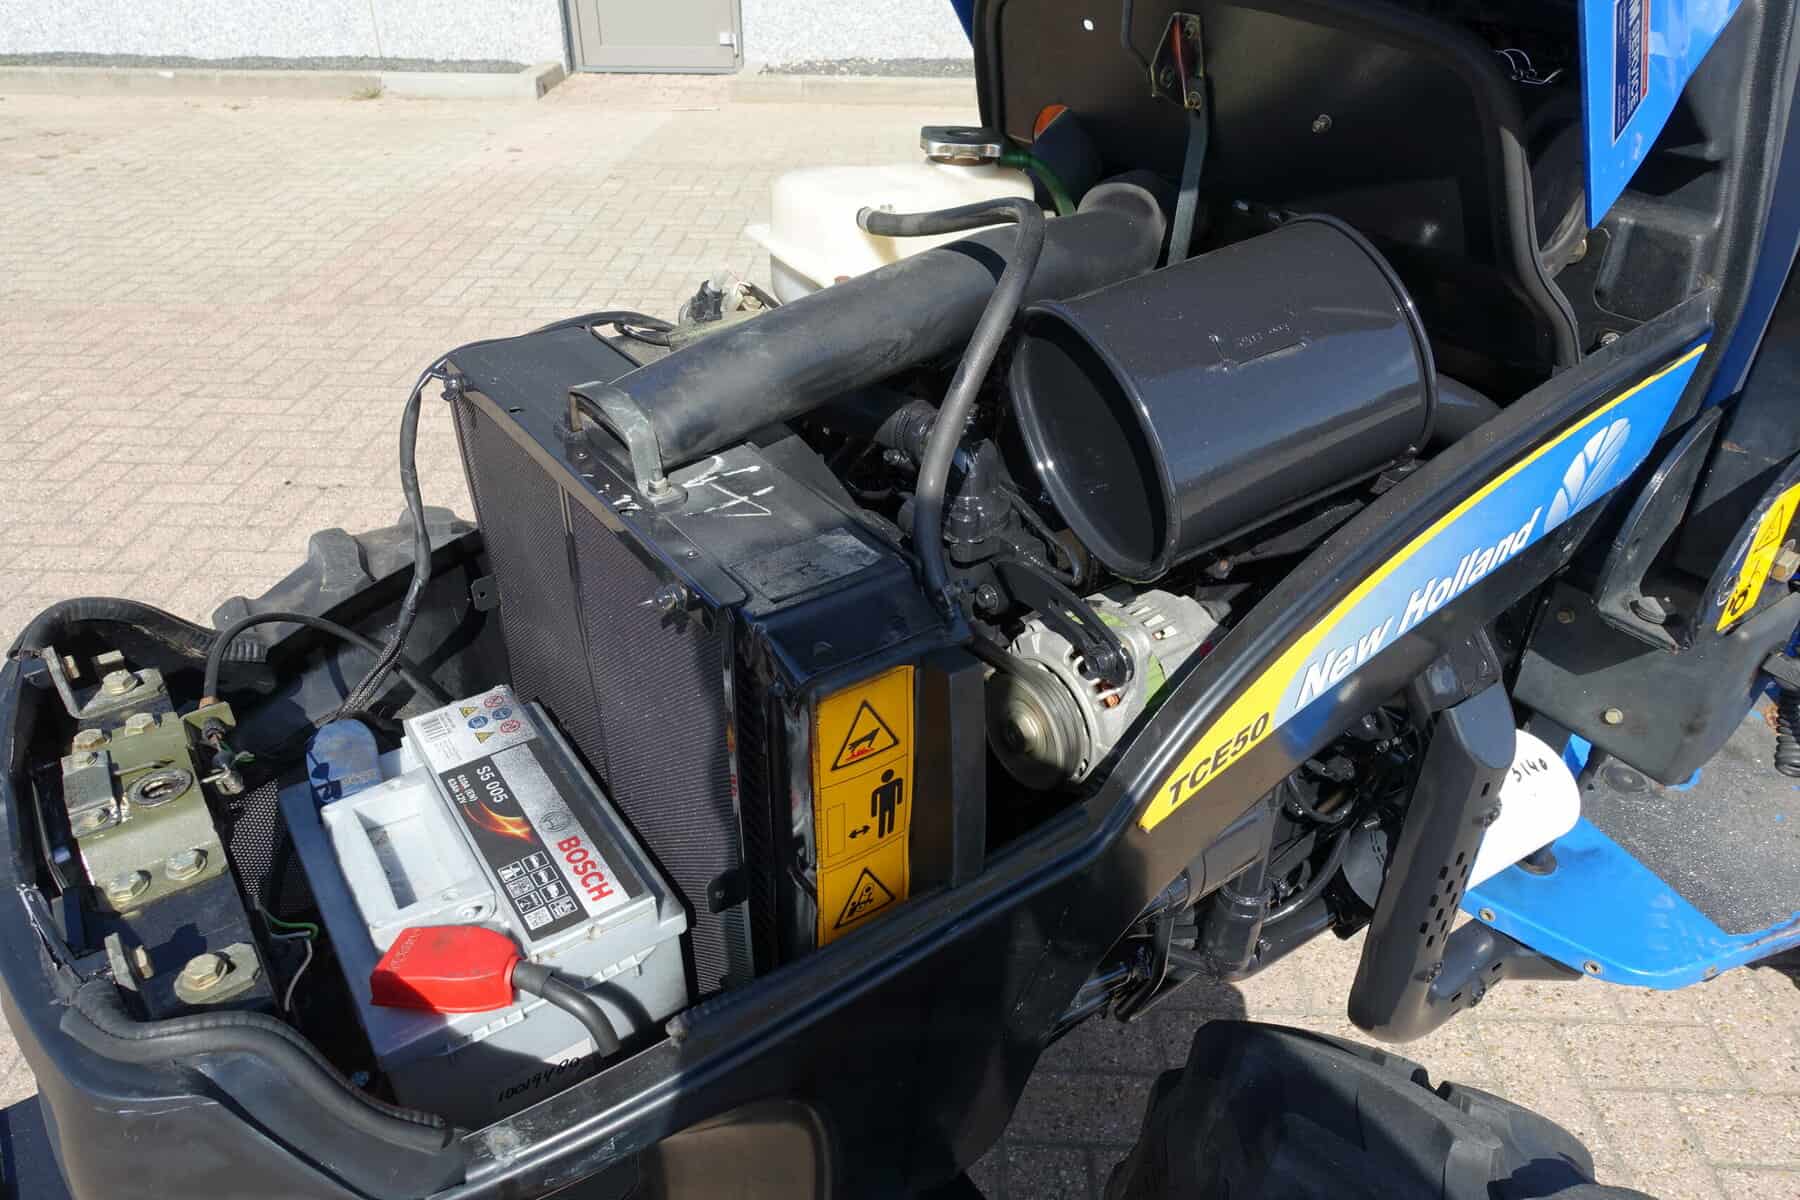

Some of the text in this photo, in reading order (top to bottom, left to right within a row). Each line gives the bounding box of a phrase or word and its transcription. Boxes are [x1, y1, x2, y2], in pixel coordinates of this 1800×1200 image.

[1294, 507, 1543, 710] New Holland
[476, 765, 509, 803] S5 005
[1167, 711, 1271, 807] TCE50
[556, 835, 615, 902] BOSCH
